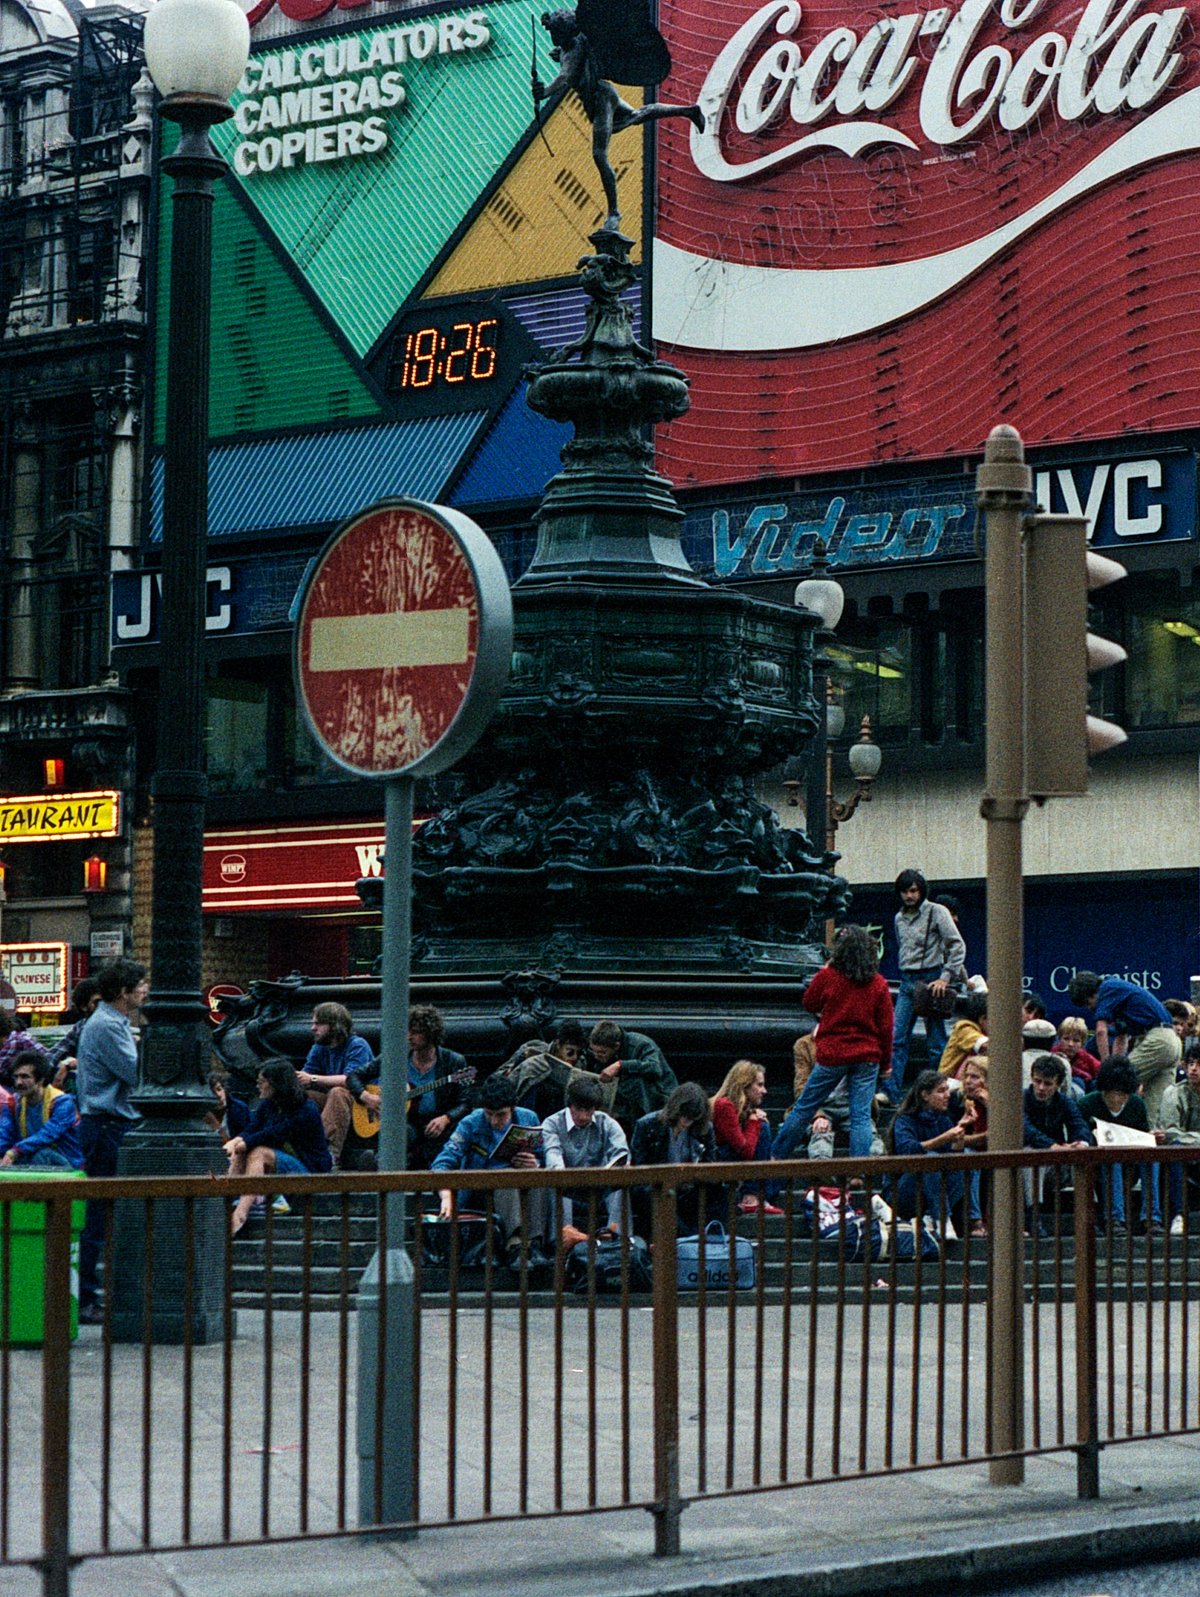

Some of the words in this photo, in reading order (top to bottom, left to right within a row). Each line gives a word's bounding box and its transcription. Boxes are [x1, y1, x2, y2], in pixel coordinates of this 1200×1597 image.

[237, 11, 491, 95] CALCULATORS
[234, 71, 406, 135] CAMERAS
[233, 116, 388, 176] COPIERS
[402, 319, 498, 388] 18:26
[712, 495, 967, 578] Video
[117, 566, 231, 639] JC
[1050, 965, 1162, 992] Cists
[688, 1269, 739, 1283] aida
